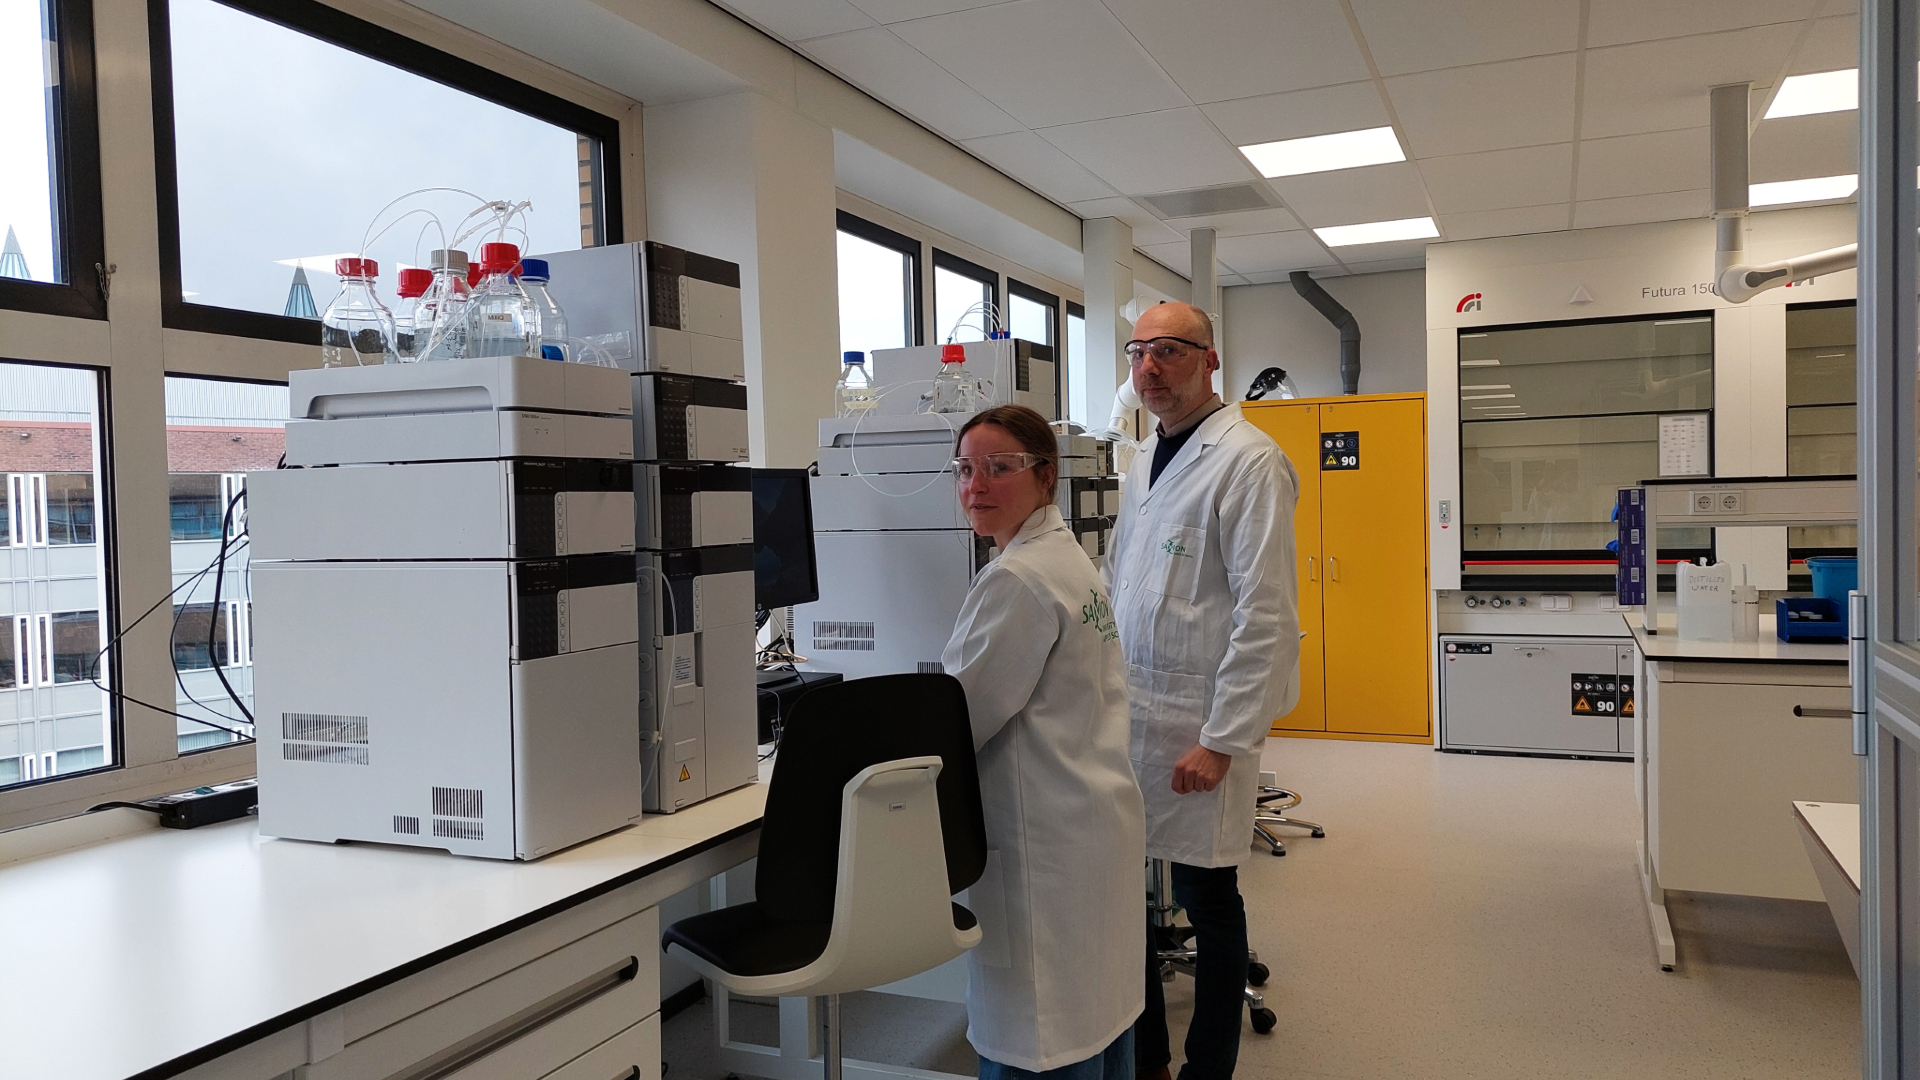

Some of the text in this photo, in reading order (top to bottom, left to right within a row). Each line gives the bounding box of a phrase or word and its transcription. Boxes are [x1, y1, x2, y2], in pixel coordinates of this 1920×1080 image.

[1642, 287, 1686, 299] Futura
[1341, 455, 1357, 466] 90
[1689, 575, 1725, 584] DISTILLED
[1597, 700, 1615, 712] 90
